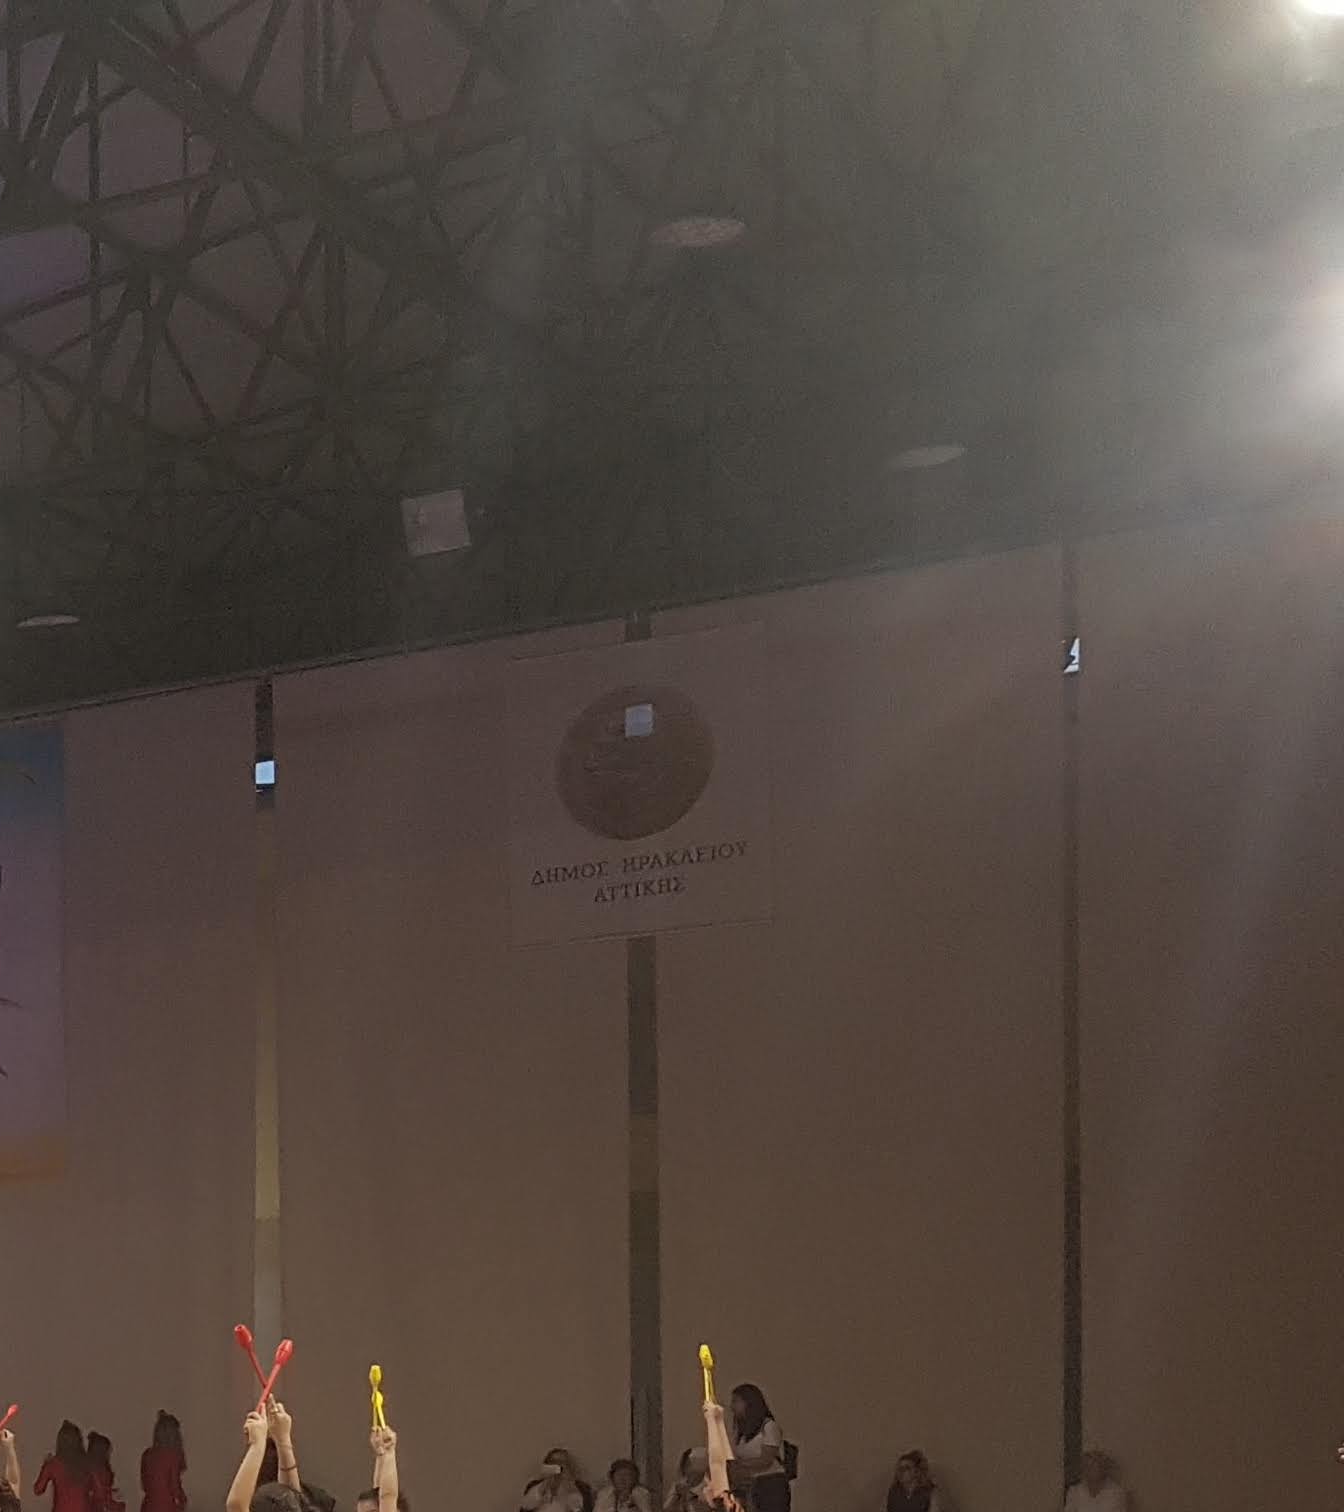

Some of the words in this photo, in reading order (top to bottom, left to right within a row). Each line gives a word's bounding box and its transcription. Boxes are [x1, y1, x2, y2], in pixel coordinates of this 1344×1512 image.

[530, 861, 609, 887] ΔΗΜΟΣ
[622, 840, 751, 874] ΗΡΑΚΛΕΙΟΥ
[593, 876, 689, 904] ΑΤΤΙΚΗΣ
